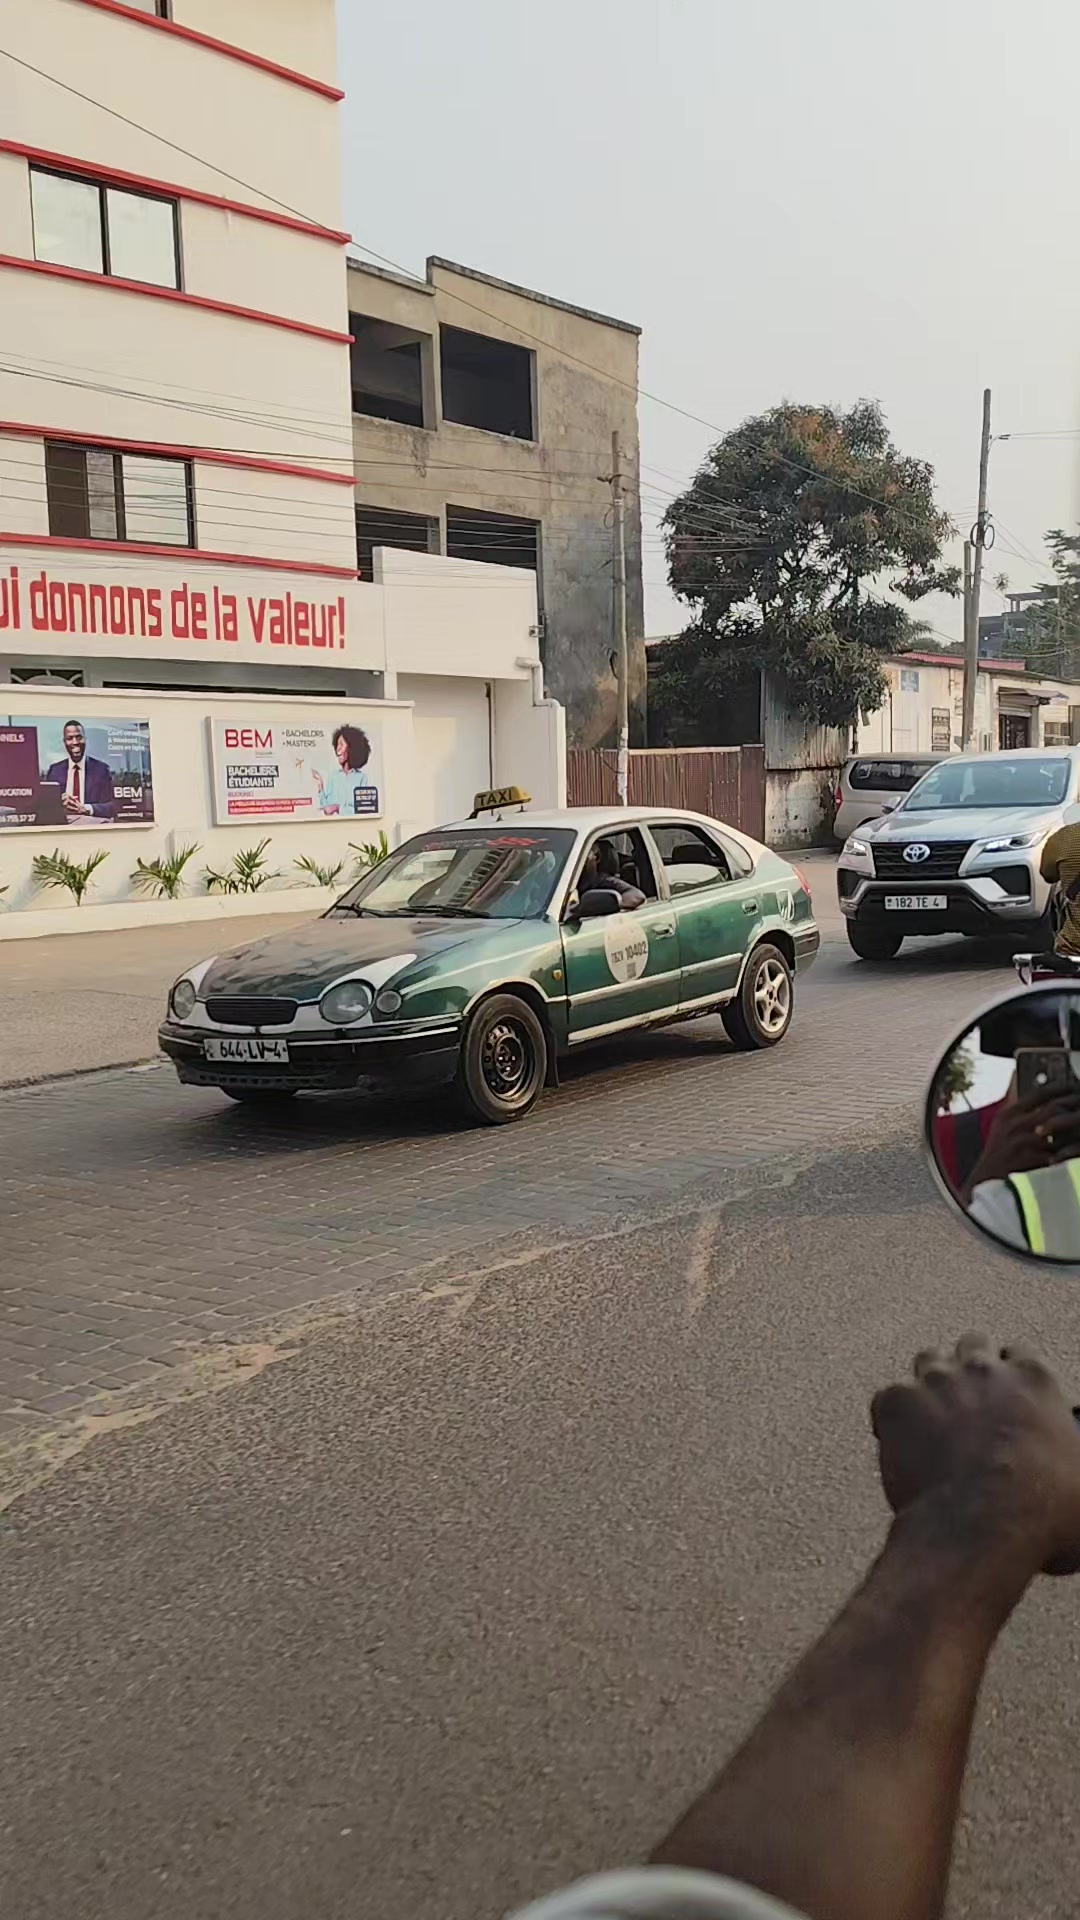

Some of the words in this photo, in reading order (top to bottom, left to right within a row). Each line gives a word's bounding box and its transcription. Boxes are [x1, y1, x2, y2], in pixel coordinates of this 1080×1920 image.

[30, 571, 162, 637] donnons
[171, 583, 207, 640] de
[213, 586, 238, 641] la
[247, 592, 345, 649] valeur!
[225, 728, 273, 749] BEM
[113, 786, 143, 798] BEM
[477, 789, 512, 806] TAXI
[895, 897, 912, 908] 182
[916, 897, 928, 908] TE
[933, 897, 940, 907] 4
